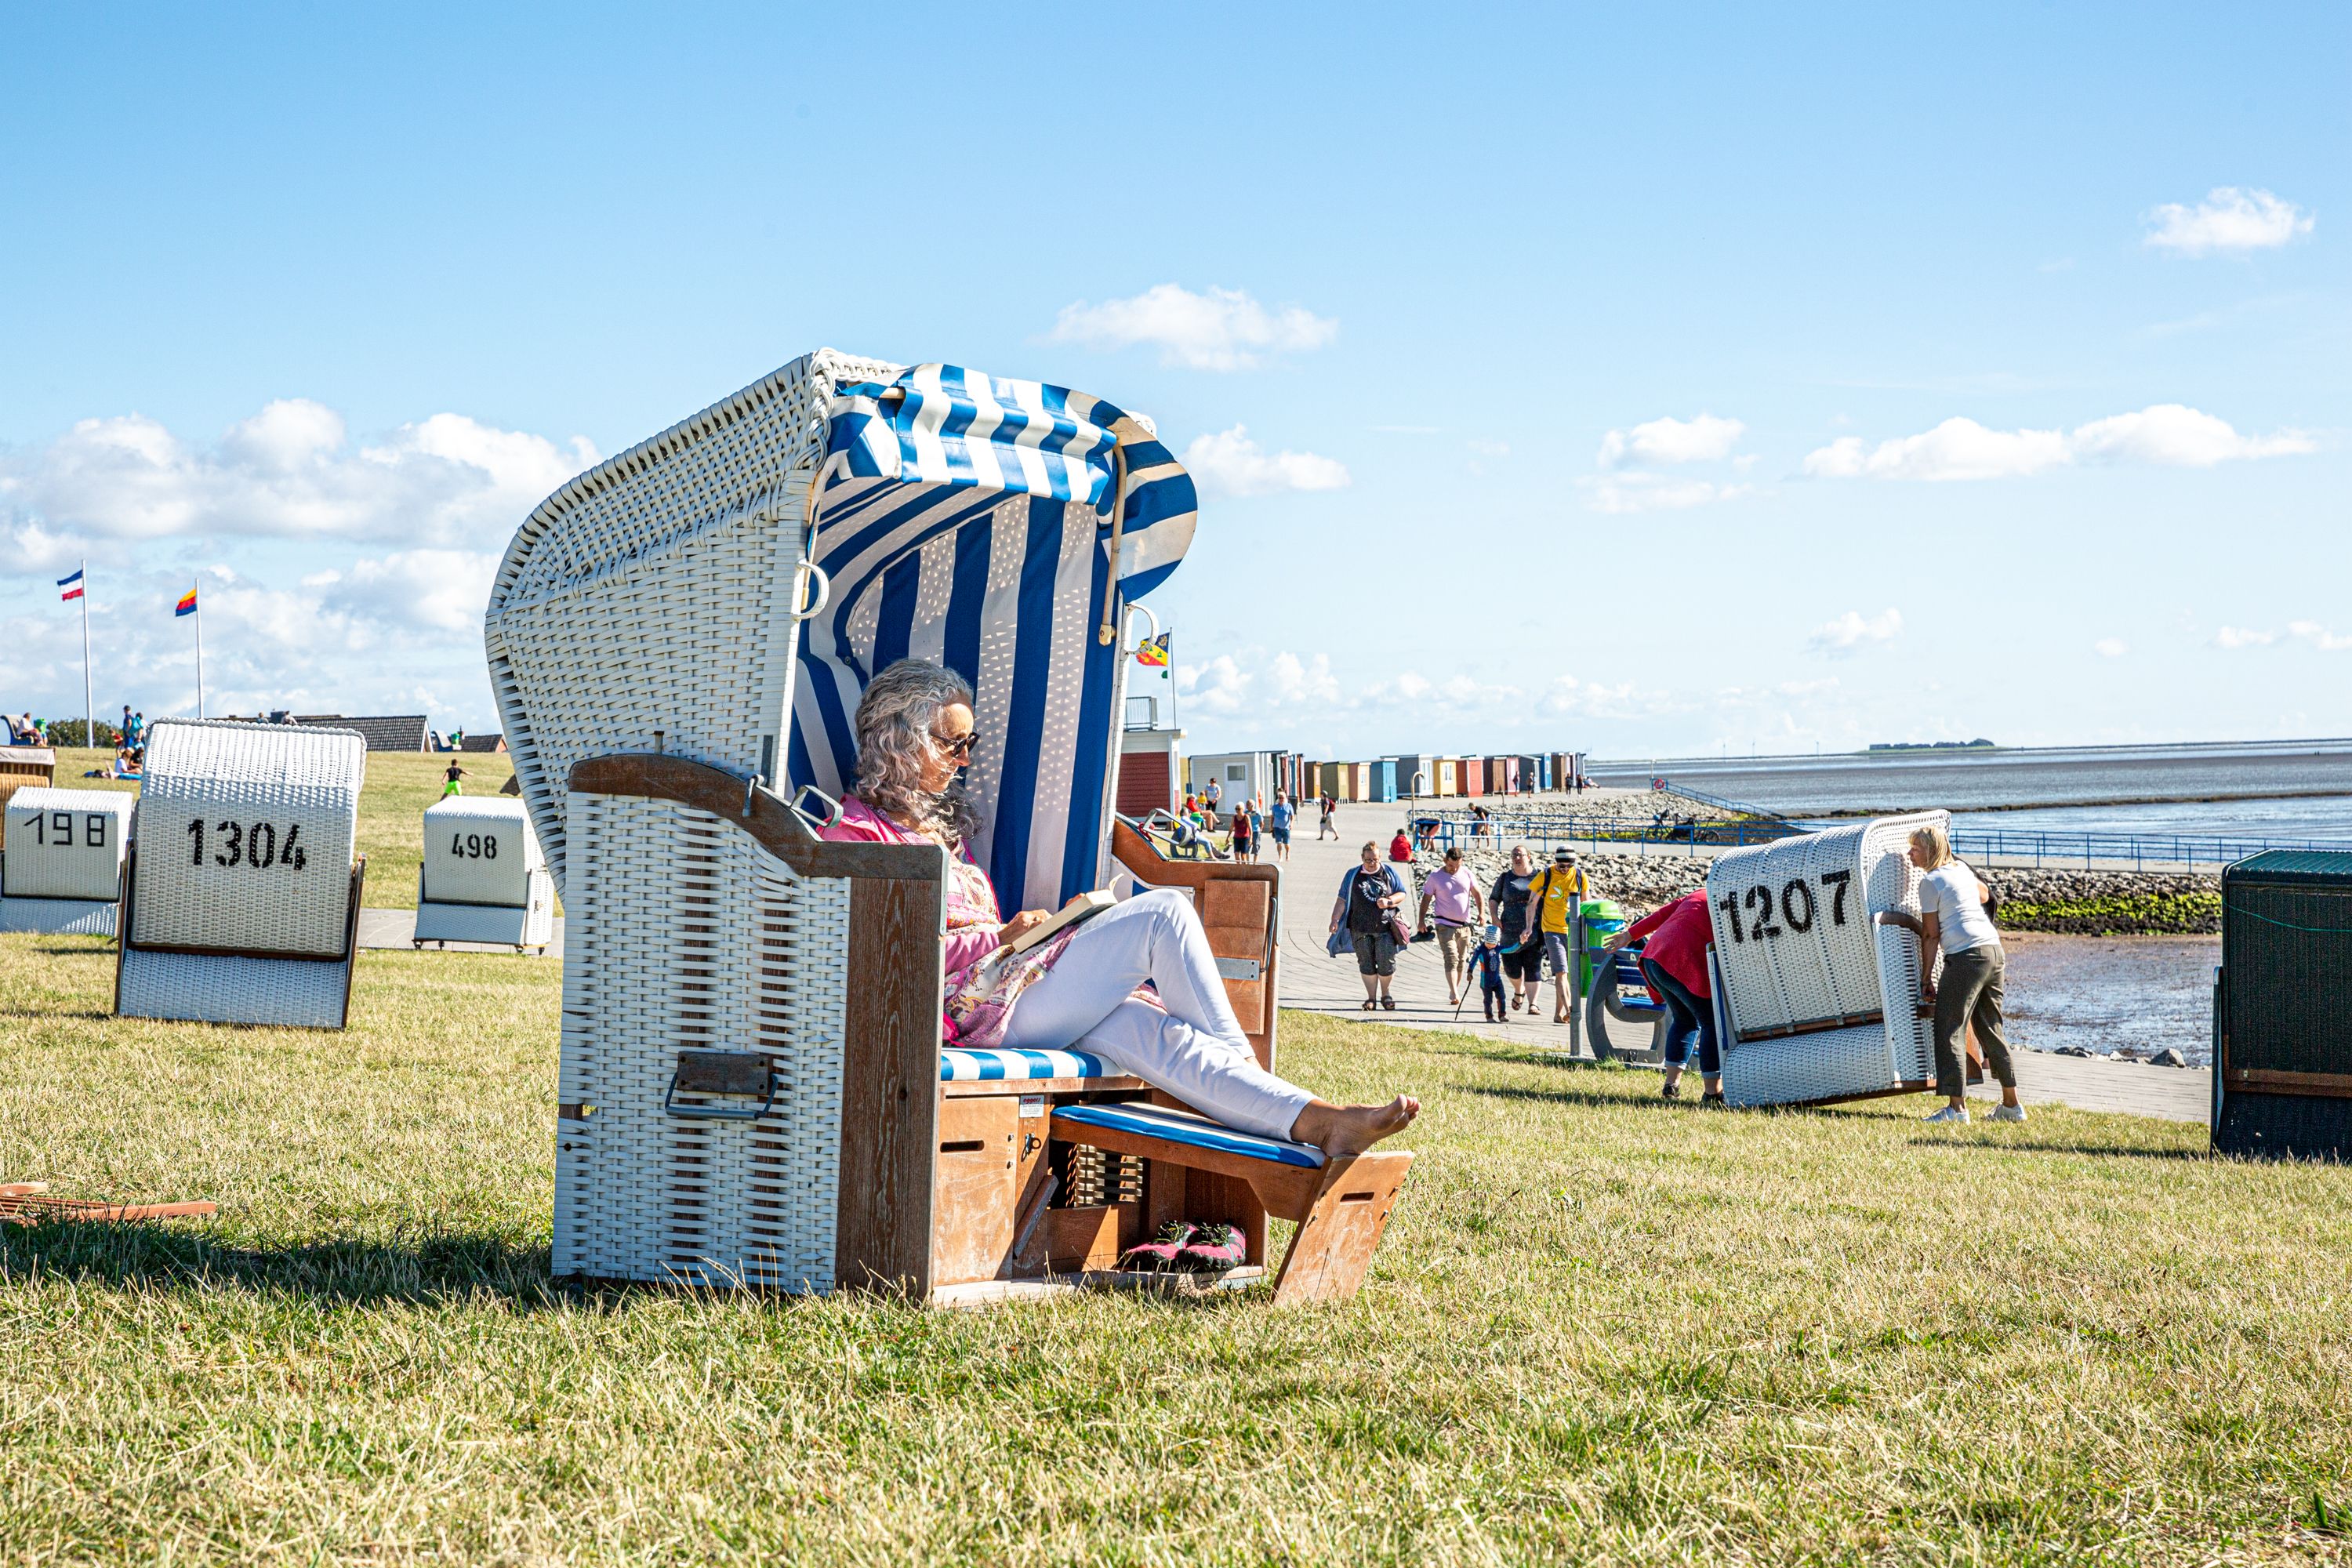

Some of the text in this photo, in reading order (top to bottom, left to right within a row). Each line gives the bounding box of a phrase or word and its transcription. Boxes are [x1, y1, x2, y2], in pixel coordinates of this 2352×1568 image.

[24, 811, 105, 847] 198
[188, 819, 307, 870] 1304
[452, 833, 497, 859] 498
[1719, 869, 1851, 943] 1207
